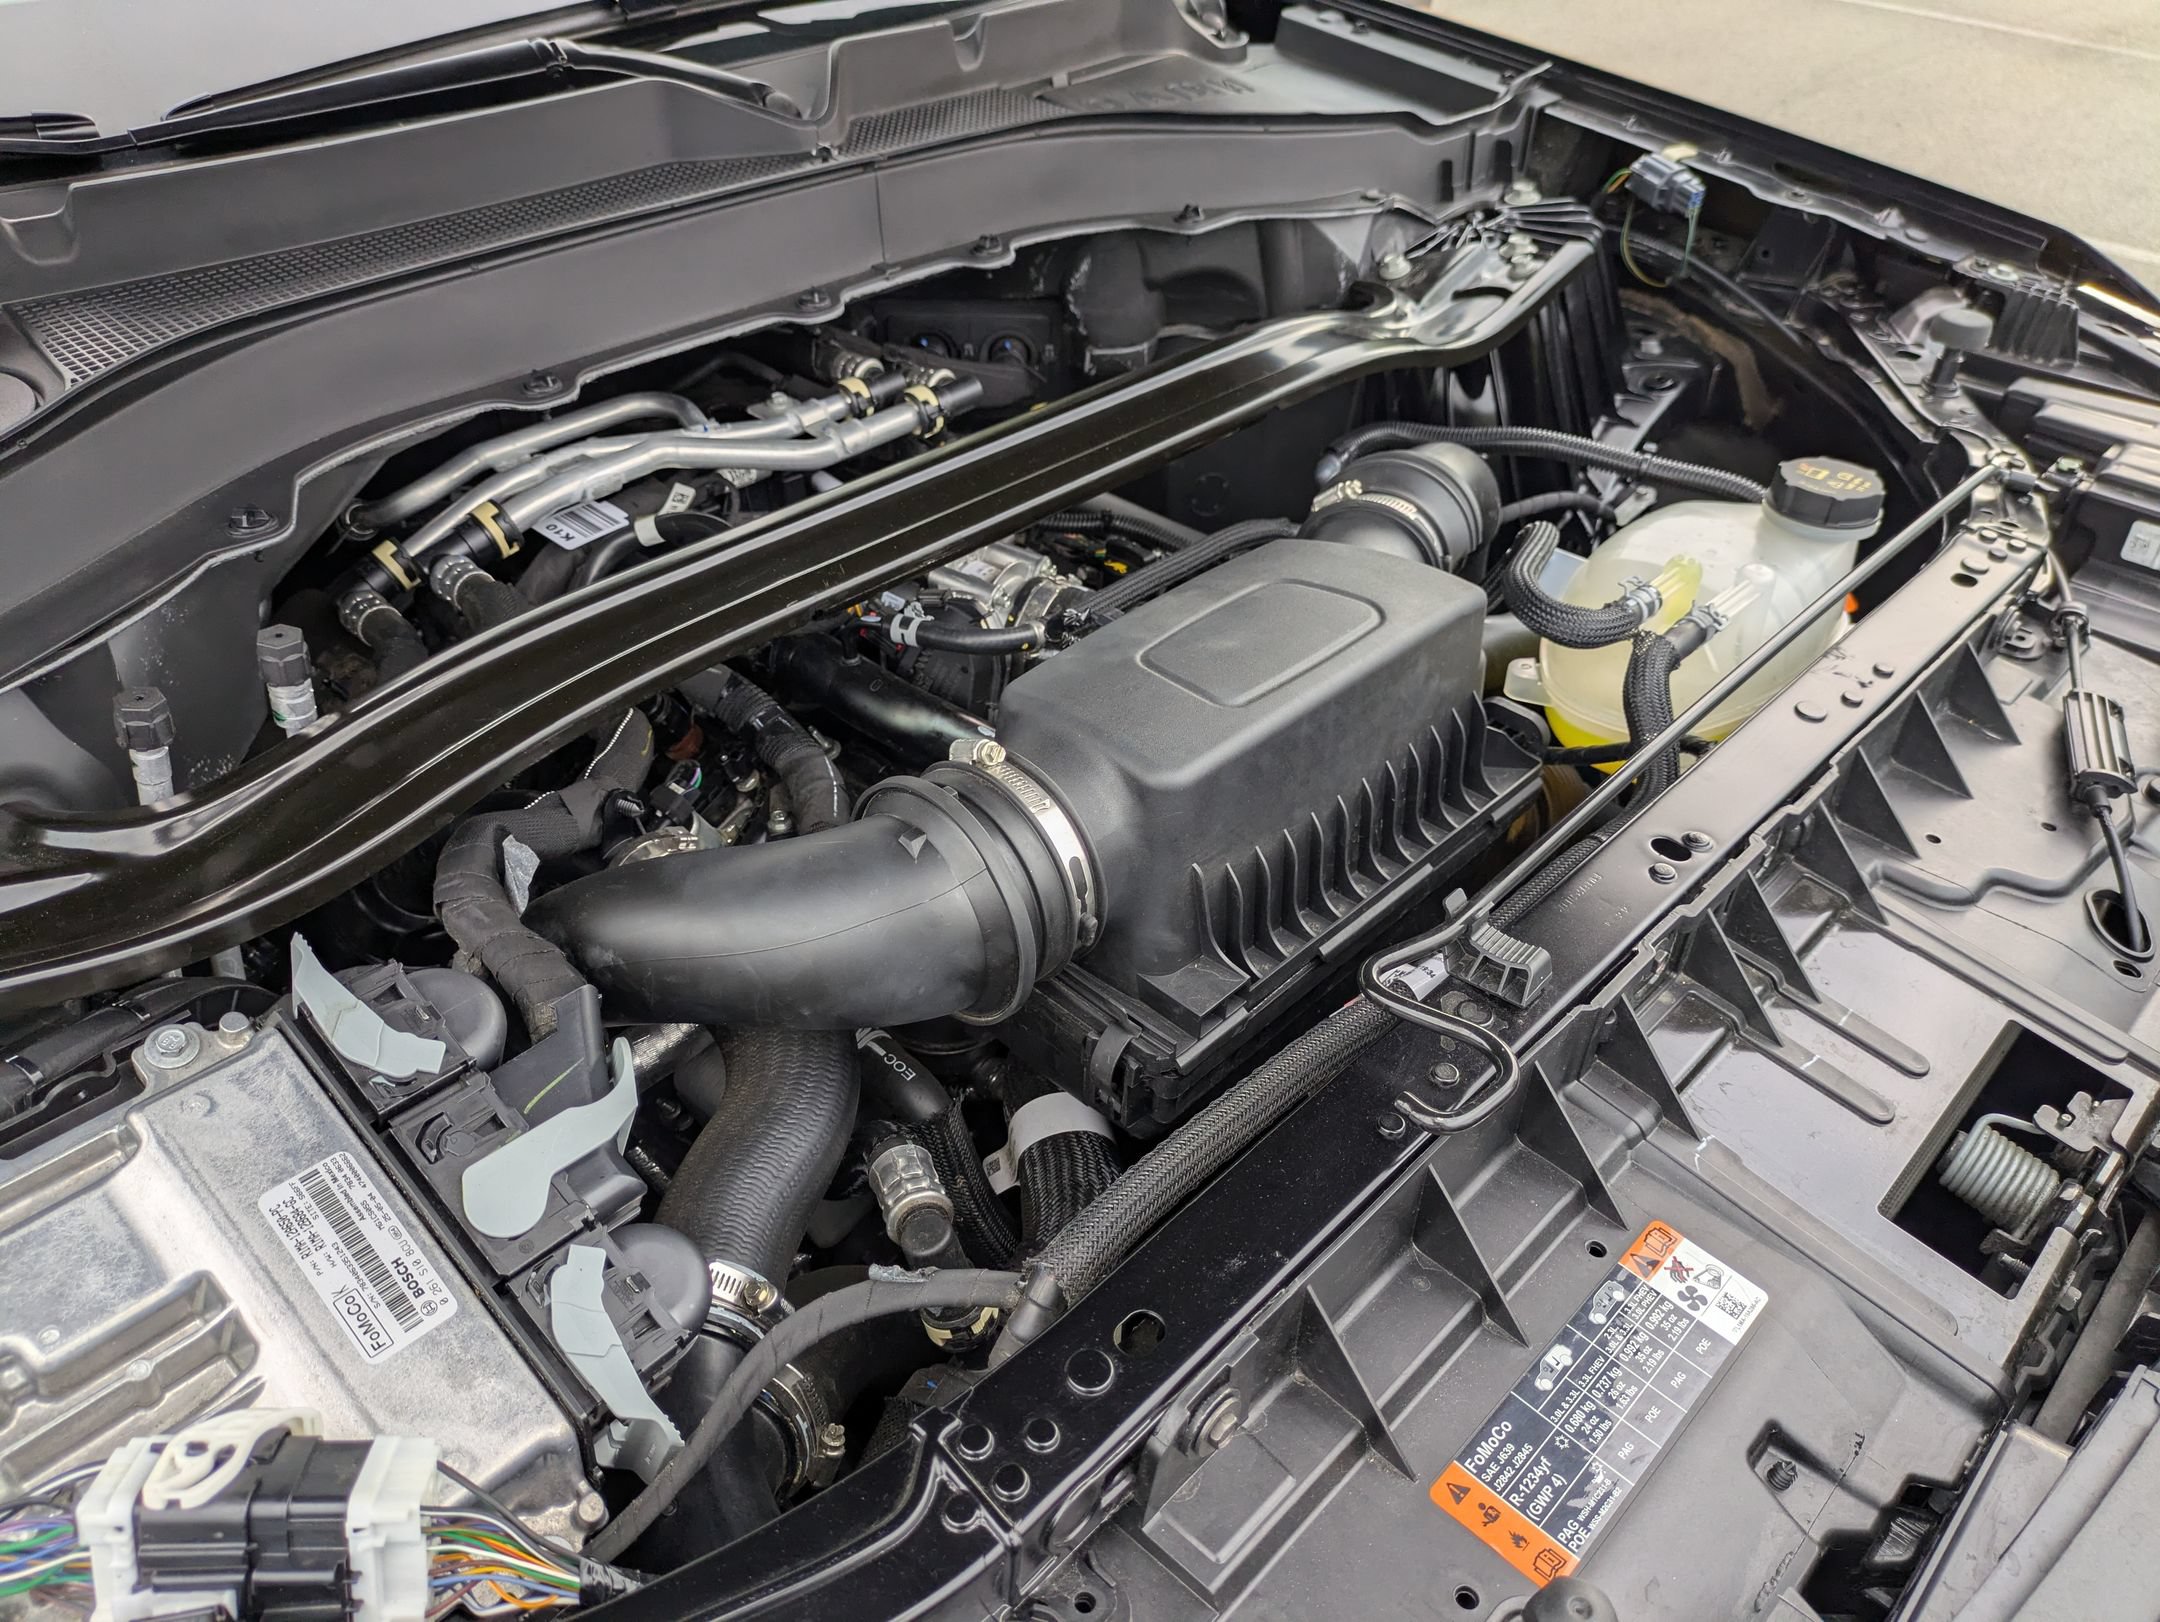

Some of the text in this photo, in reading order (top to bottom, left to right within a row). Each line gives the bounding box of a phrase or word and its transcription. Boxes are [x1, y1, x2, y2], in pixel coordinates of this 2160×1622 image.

[546, 524, 575, 541] K10
[884, 1054, 917, 1081] EOC
[320, 1161, 339, 1183] Mexico
[302, 1200, 319, 1220] SITE:
[339, 1189, 366, 1221] Assembled
[397, 1238, 415, 1257] 8CU
[308, 1258, 323, 1276] P/N:
[390, 1256, 425, 1298] BOSCH
[366, 1291, 381, 1309] S/N:
[425, 1278, 442, 1296] 261
[1633, 1284, 1650, 1302] FHEV
[1641, 1289, 1658, 1308] PHEV
[330, 1284, 387, 1351] FoMoCo K
[1644, 1298, 1674, 1330] 0.992 kg
[1659, 1313, 1678, 1331] 35 oz
[1604, 1338, 1619, 1353] 3.0L
[1619, 1320, 1633, 1335] 3.3L
[1667, 1316, 1690, 1341] 2.19 lbs
[1618, 1329, 1650, 1362] 0.992 kg
[1634, 1344, 1652, 1363] 35 oz
[1695, 1337, 1711, 1355] POE
[1577, 1355, 1606, 1387] 3.3L FHEV
[1641, 1347, 1665, 1374] 2.19 lbs
[1590, 1364, 1623, 1399] 0.737 kg
[1607, 1380, 1626, 1399] 26 oz
[1670, 1370, 1686, 1388] PAG
[1549, 1387, 1580, 1423] 3.0L & 3.3L
[1615, 1383, 1638, 1410] 1.63 lbs
[1563, 1398, 1597, 1433] 0.680 kg
[1580, 1414, 1600, 1434] 24 oz
[1644, 1405, 1661, 1423] POE
[1588, 1417, 1612, 1445] 1.50 lbs
[1462, 1417, 1514, 1474] FoMoCo
[1616, 1440, 1634, 1460] PAG
[1480, 1441, 1516, 1483] SAE J639
[1491, 1442, 1534, 1492] J2842 J2845
[1508, 1454, 1556, 1509] R-1234yf
[1524, 1471, 1568, 1521] (GWP 4)
[1556, 1517, 1580, 1544] PAG
[1567, 1526, 1591, 1552] POE
